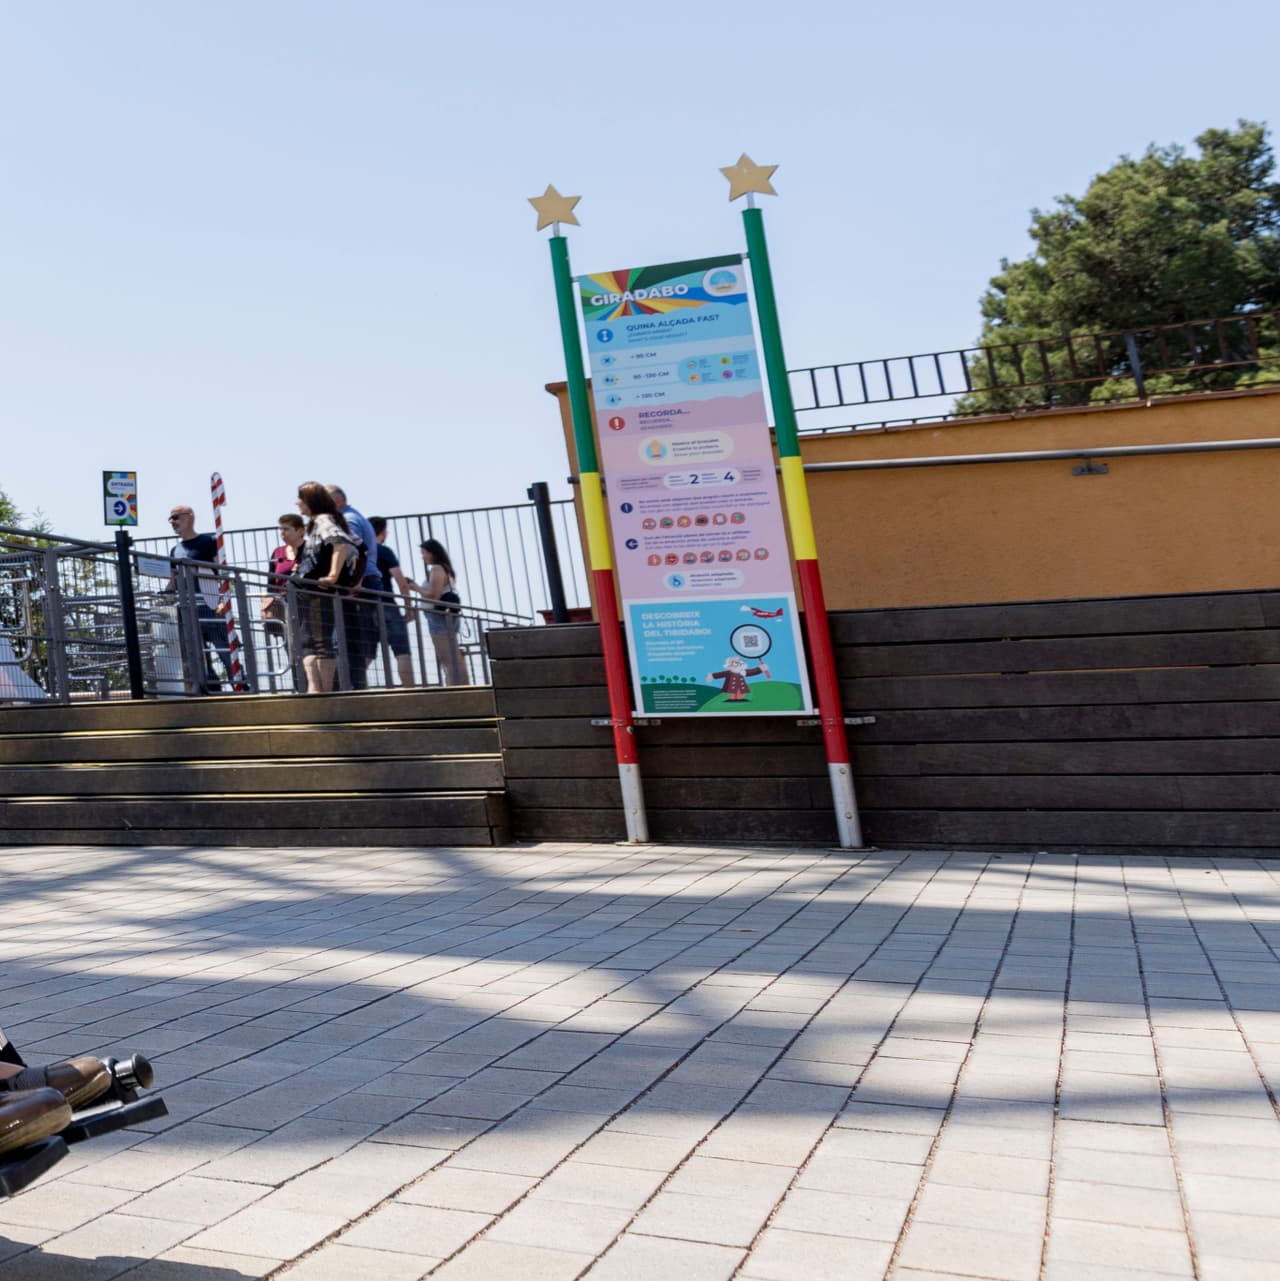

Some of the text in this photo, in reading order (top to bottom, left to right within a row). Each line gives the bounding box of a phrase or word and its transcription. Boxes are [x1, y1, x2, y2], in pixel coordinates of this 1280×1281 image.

[590, 284, 689, 306] GIRADABO
[626, 321, 656, 332] QUINA
[658, 317, 696, 328] ALÇADA
[689, 474, 700, 485] 2
[724, 471, 735, 482] 4
